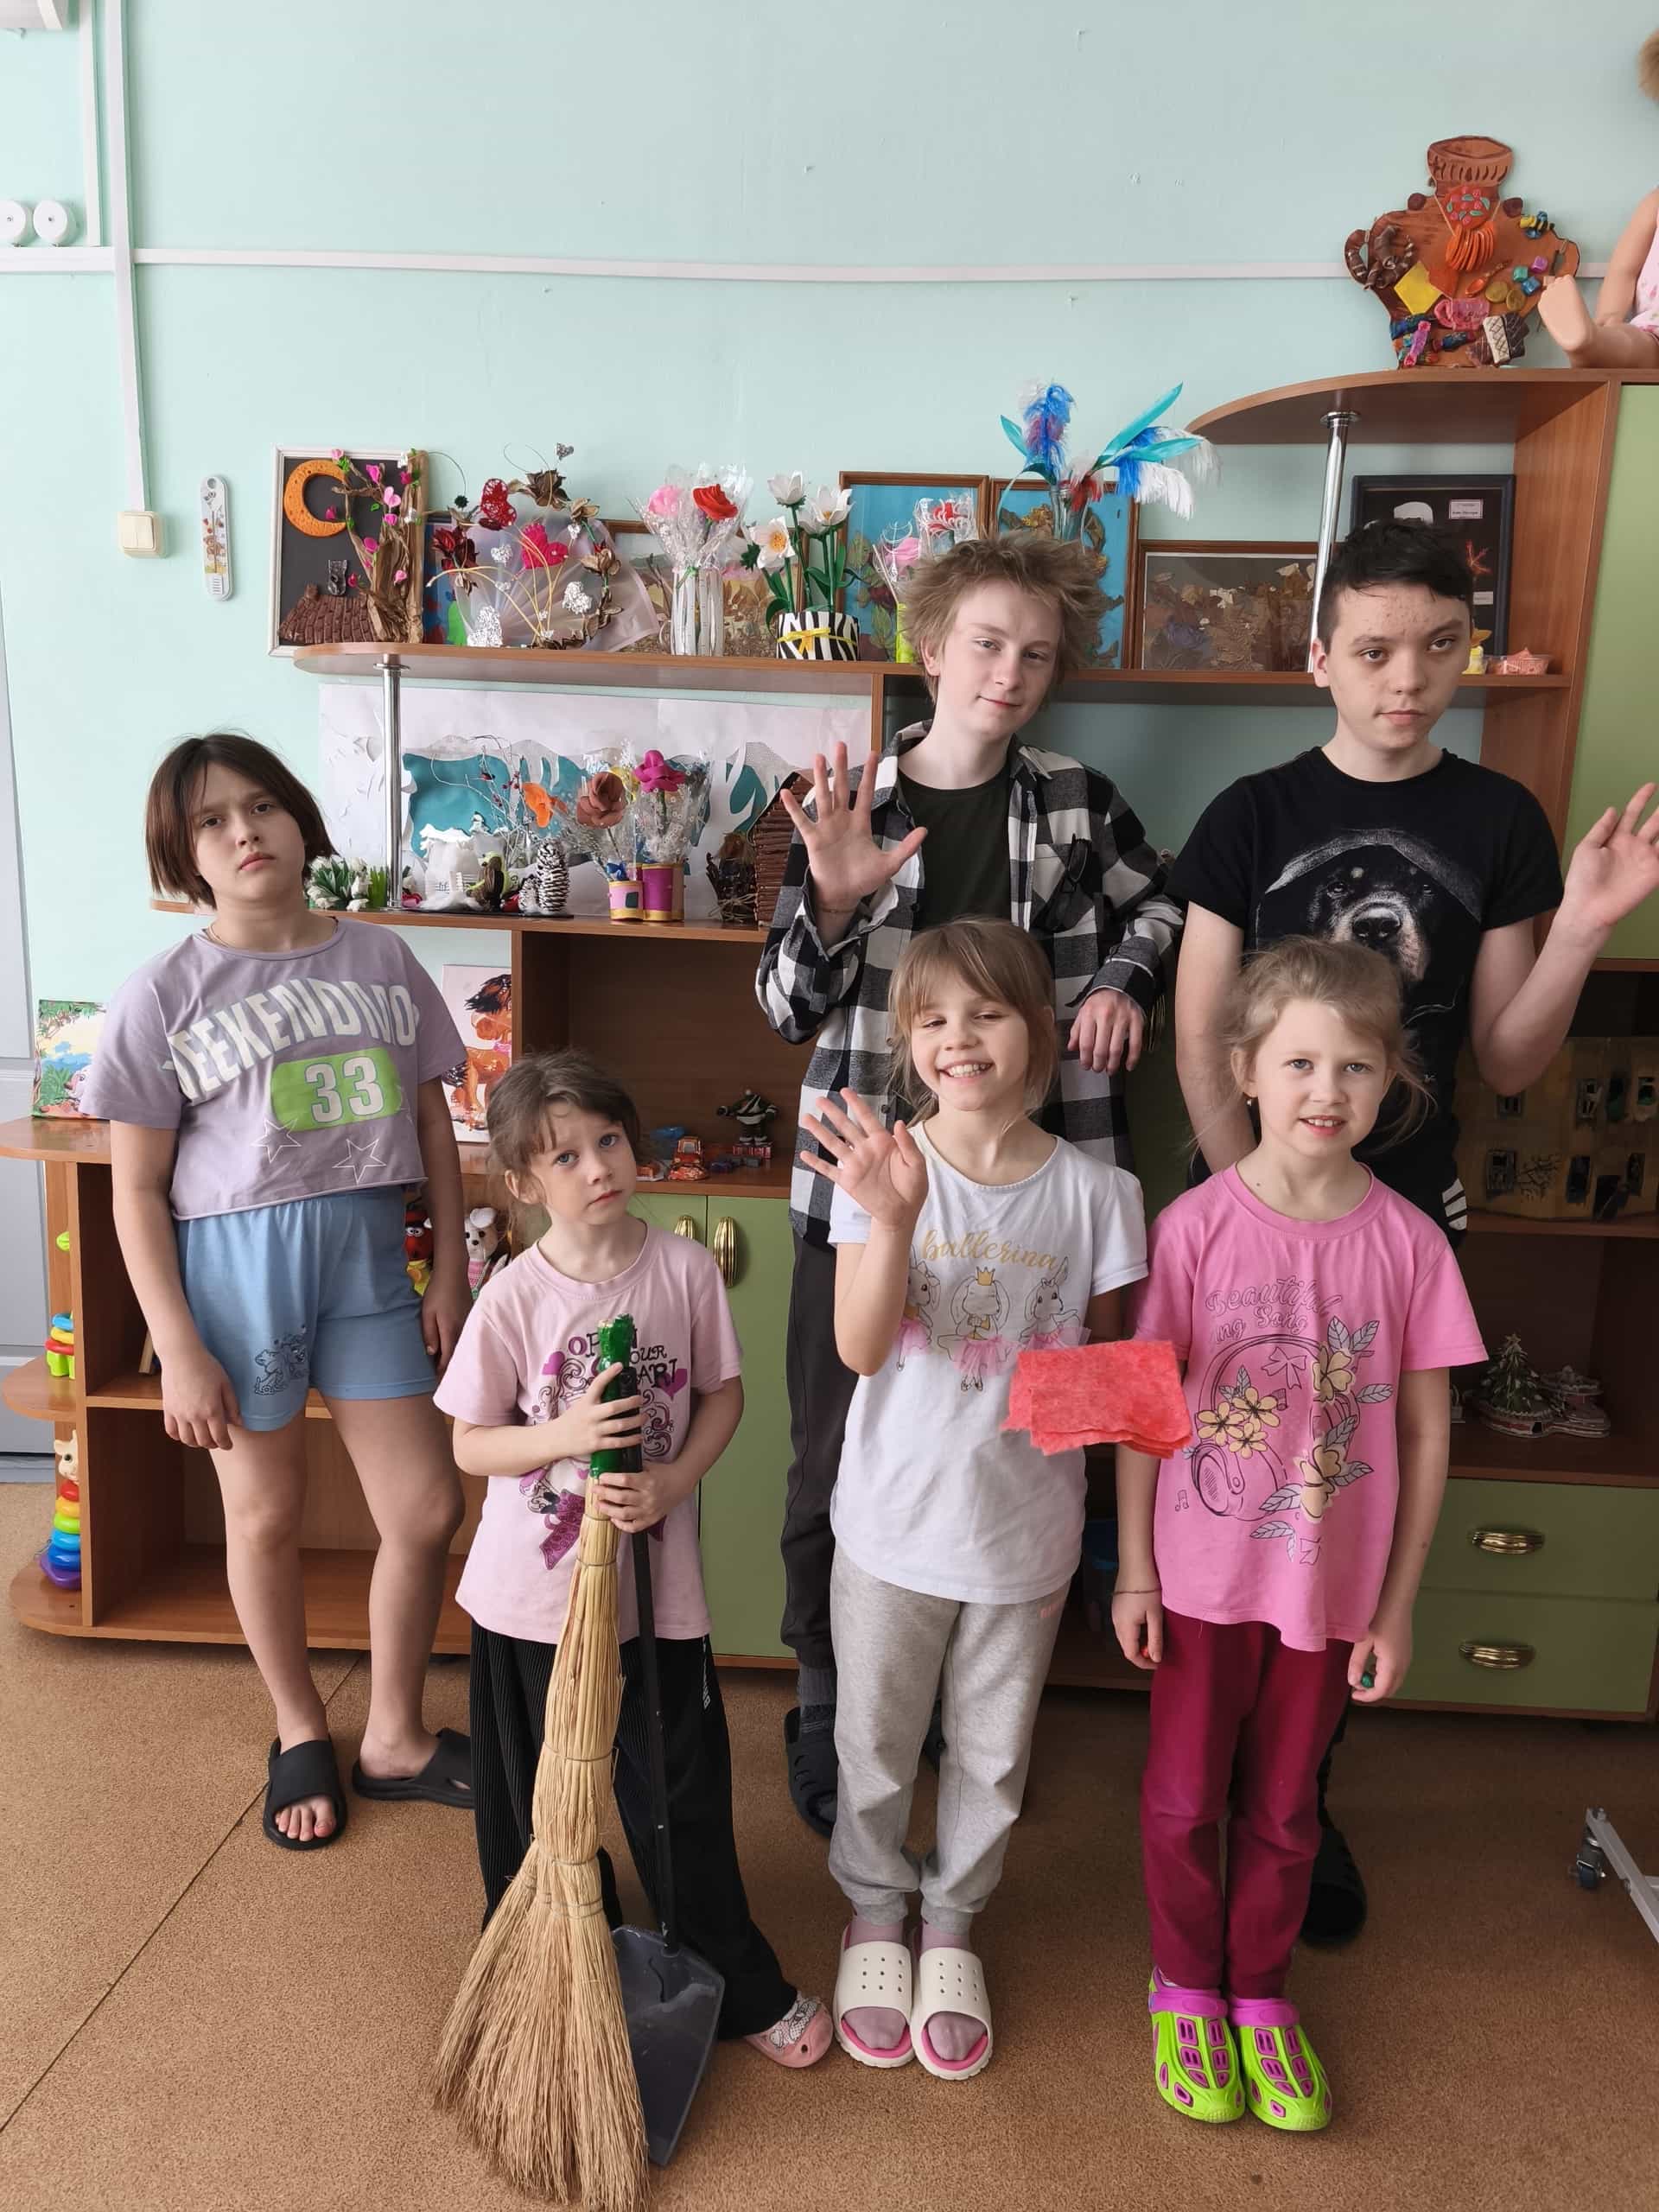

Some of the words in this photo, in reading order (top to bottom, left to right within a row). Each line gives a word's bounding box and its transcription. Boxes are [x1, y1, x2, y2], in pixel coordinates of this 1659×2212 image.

[304, 1056, 385, 1122] 33
[922, 1230, 1058, 1270] ballerina
[1254, 1304, 1307, 1335] Song
[630, 1345, 667, 1364] OUR
